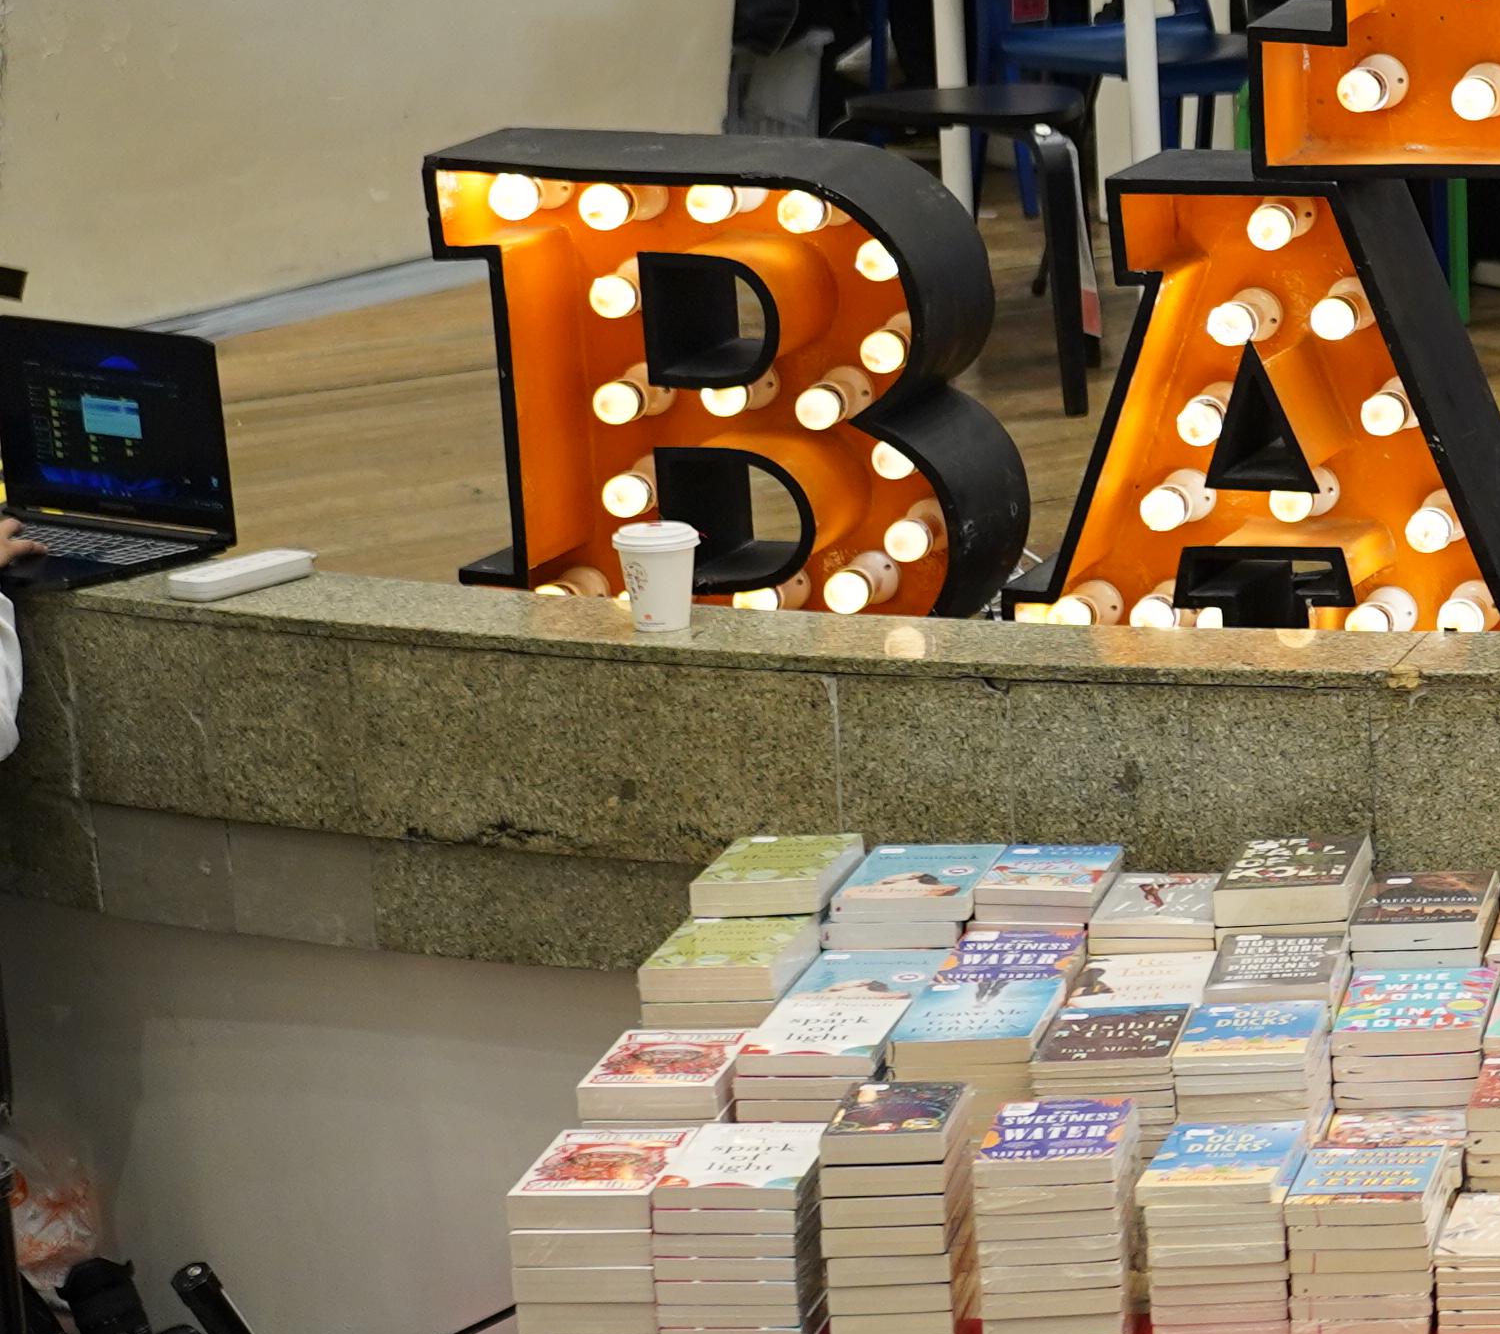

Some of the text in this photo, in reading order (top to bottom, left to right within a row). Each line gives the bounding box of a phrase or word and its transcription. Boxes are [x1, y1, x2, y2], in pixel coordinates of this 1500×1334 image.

[1384, 982, 1458, 991] WISE
[1363, 992, 1473, 1000] WOMEN
[789, 1016, 870, 1026] spark
[808, 1025, 829, 1033] of
[784, 1033, 850, 1044] light
[1002, 1112, 1120, 1126] SWEETNESS
[1004, 1125, 1108, 1141] WATER
[1208, 1134, 1255, 1144] OLD
[1187, 1141, 1272, 1153] DUCKS'
